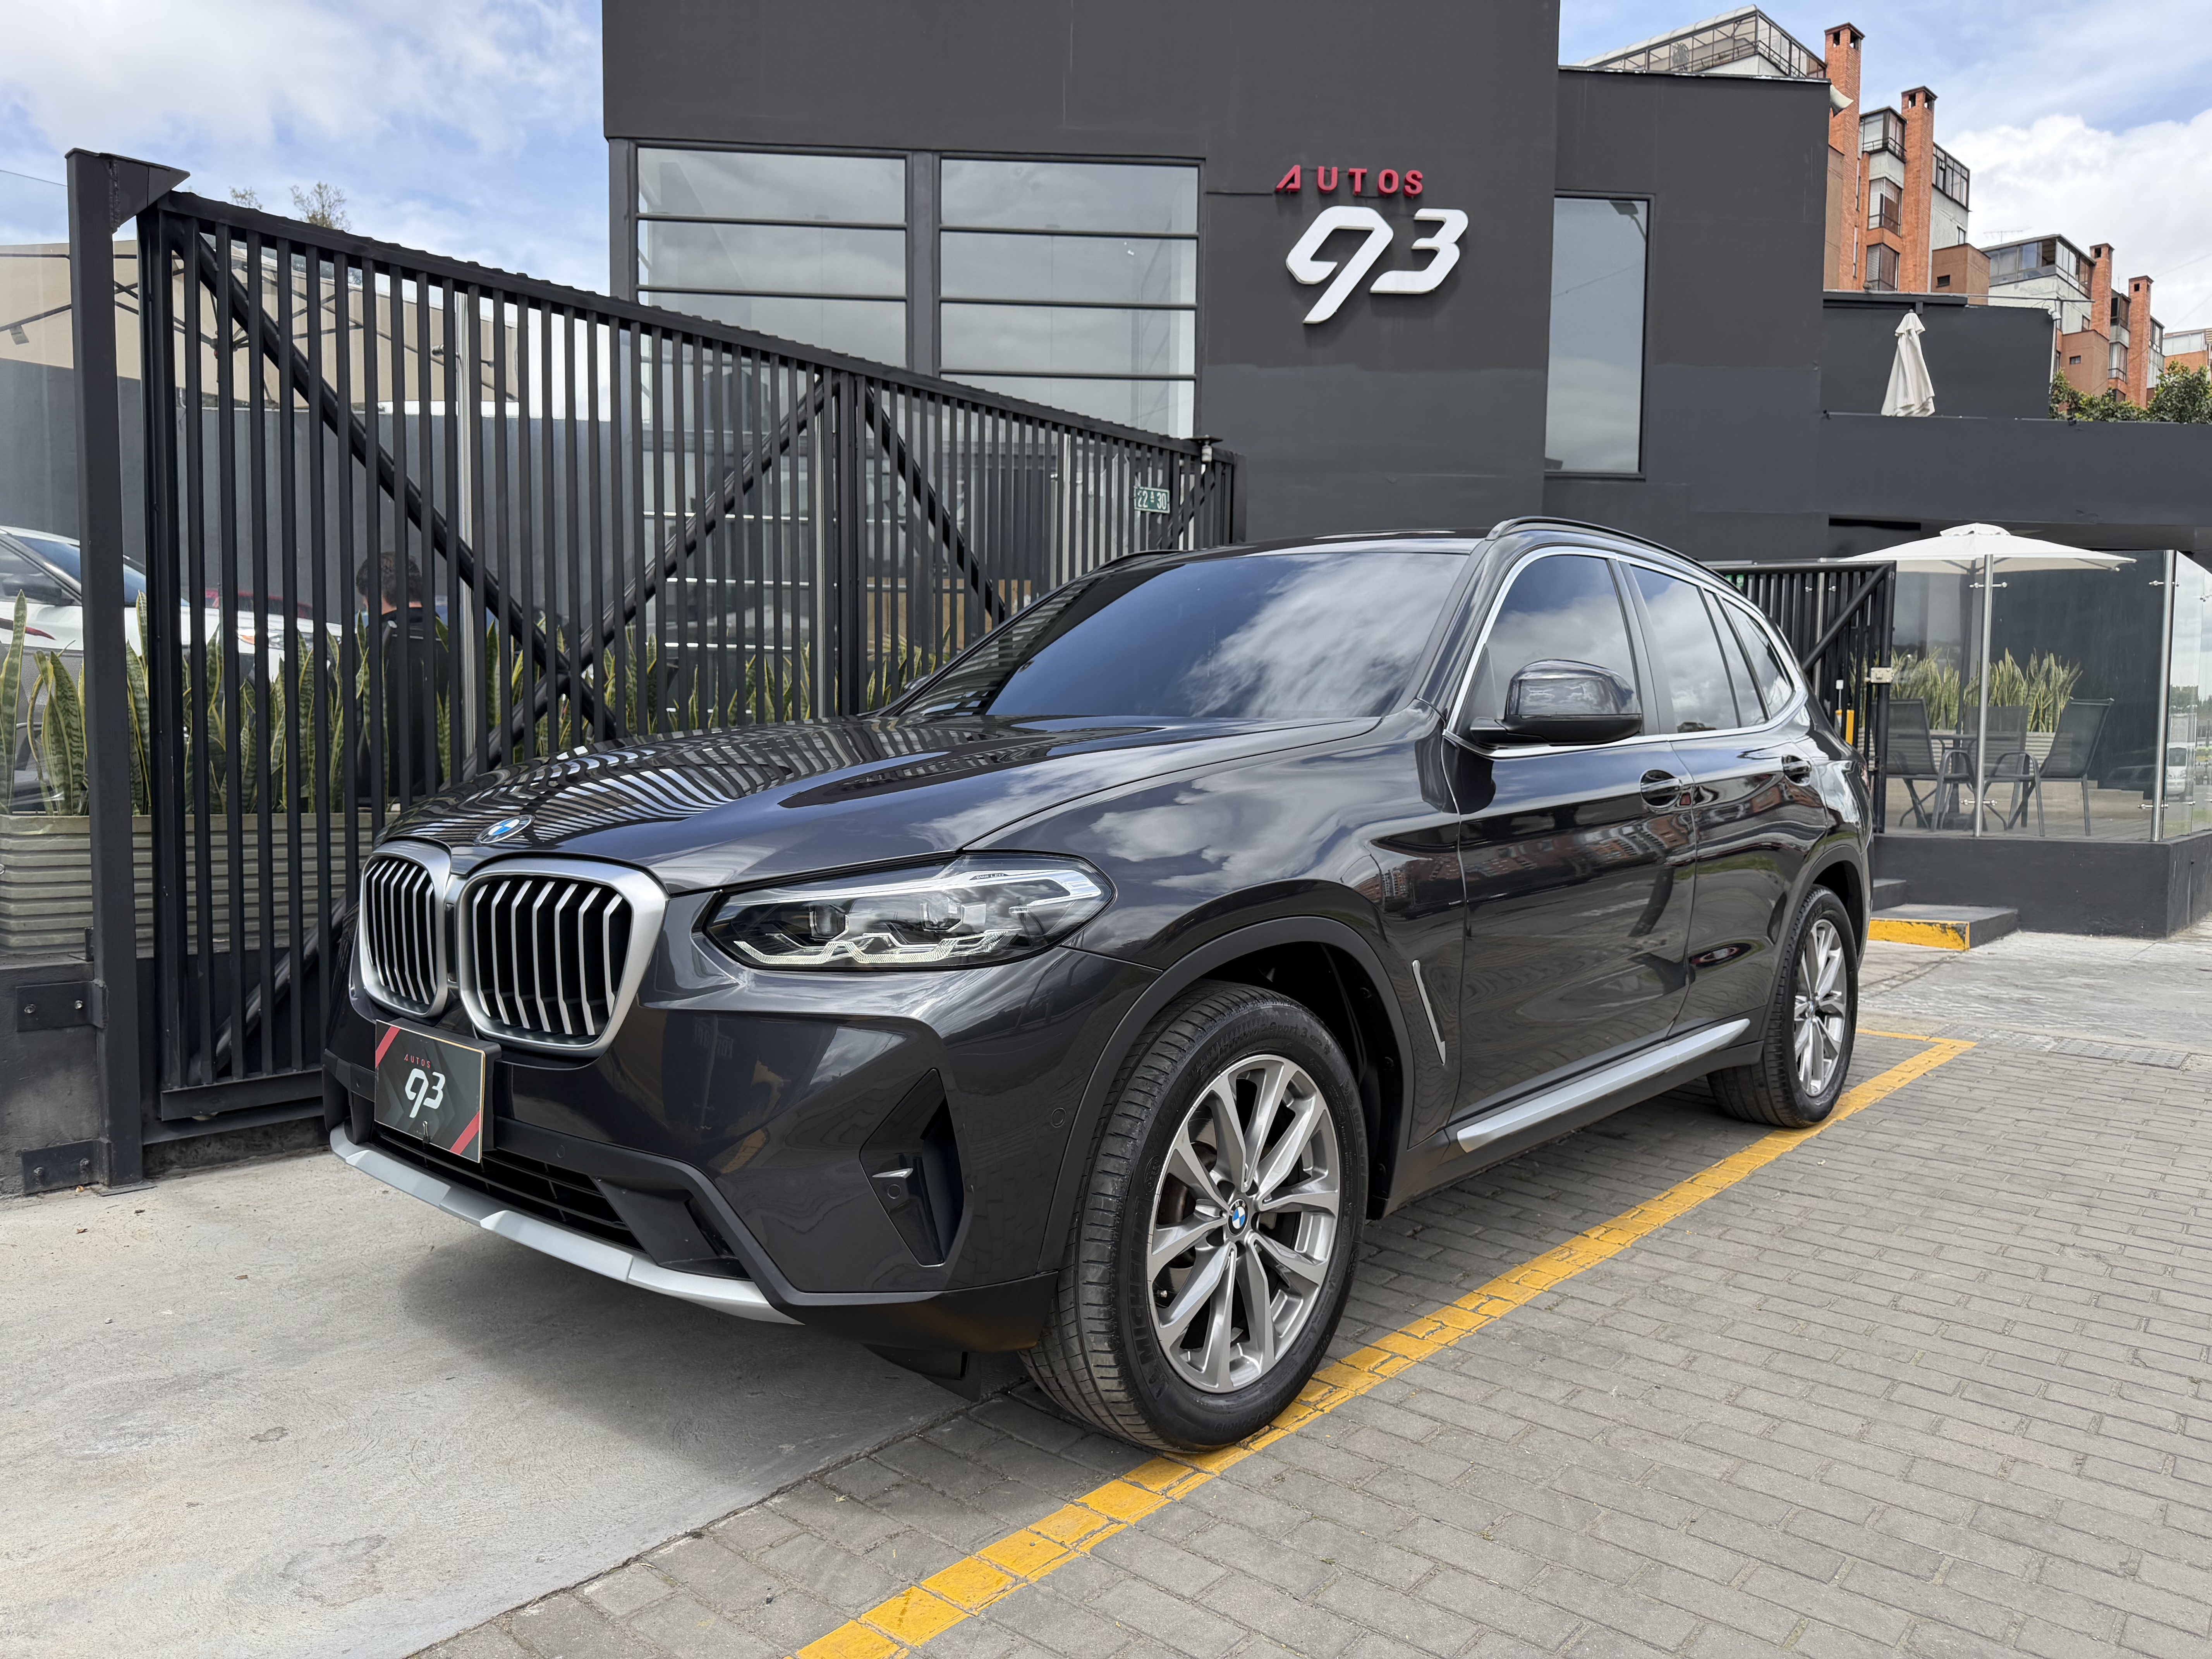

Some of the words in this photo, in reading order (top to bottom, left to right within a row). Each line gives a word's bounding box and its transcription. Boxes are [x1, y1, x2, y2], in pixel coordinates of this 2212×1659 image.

[1275, 165, 1423, 198] AUTOS
[1286, 205, 1468, 324] 93
[404, 1054, 431, 1069] AUTOS
[405, 1068, 445, 1118] 93
